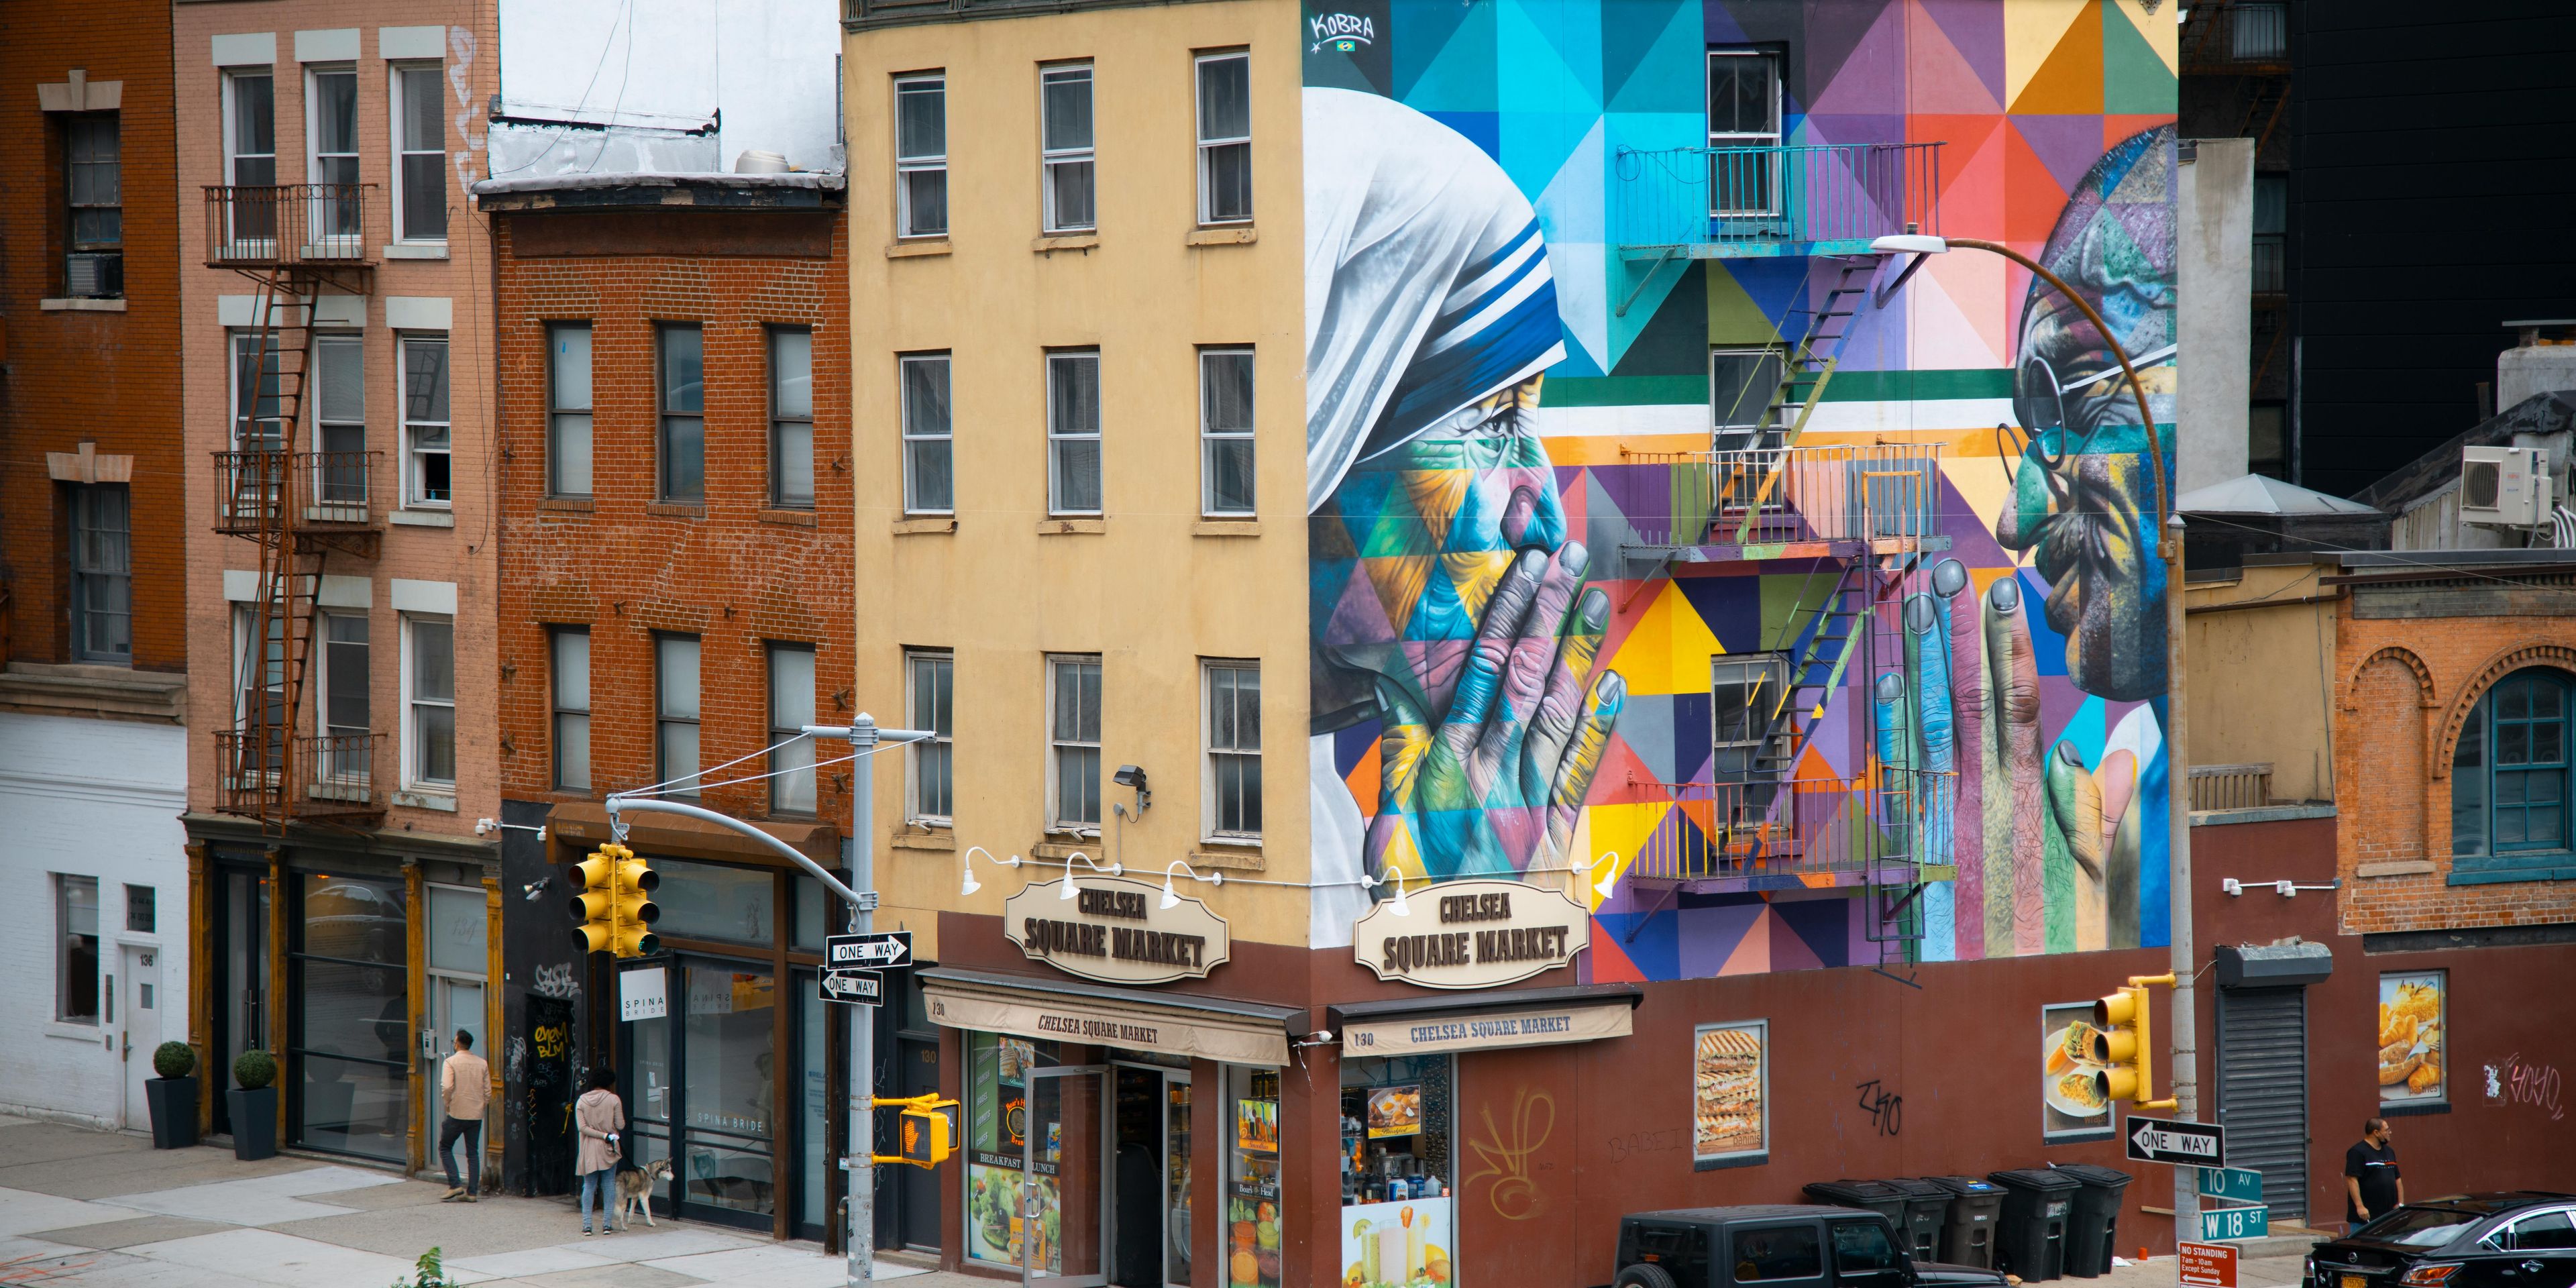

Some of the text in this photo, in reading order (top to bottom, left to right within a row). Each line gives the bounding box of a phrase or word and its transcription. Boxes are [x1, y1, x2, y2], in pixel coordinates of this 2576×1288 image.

[1310, 13, 1374, 39] KOBRA
[1078, 888, 1147, 920] CHELSEA
[1440, 892, 1511, 923] CHELSEA
[1024, 917, 1205, 967] SQUARE MARKET
[1384, 925, 1569, 973] SQUARE MARKET
[840, 943, 899, 959] ONE WAY
[140, 954, 154, 967] 136
[829, 977, 874, 995] ONE WAY
[626, 997, 663, 1008] SPINA
[932, 1002, 945, 1016] 130
[626, 1007, 664, 1016] BRIDE
[1038, 1014, 1158, 1044] CHELSEA SQUARE MARKET
[1410, 1016, 1571, 1043] CHELSEA SQUARE MARKET
[1354, 1032, 1374, 1046] 130
[921, 1049, 936, 1064] 130
[2409, 1084, 2438, 1096] pastries
[698, 1113, 762, 1132] SPINA BRIDE
[2084, 1114, 2107, 1127] wraps
[1011, 1134, 1025, 1147] Bran
[1734, 1134, 1761, 1146] paninis
[2142, 1132, 2210, 1153] ONE WAY
[980, 1152, 1055, 1174] BREAKFAST LUNCH
[2208, 1169, 2251, 1193] 10 AV
[1239, 1184, 1253, 1194] Boar's
[1260, 1186, 1273, 1197] Head
[2206, 1211, 2262, 1238] W 18 ST
[2182, 1246, 2227, 1258] NO STANDING
[2182, 1256, 2194, 1264] 7am
[2198, 1258, 2213, 1266] 10am
[2182, 1264, 2220, 1277] Except Sunday
